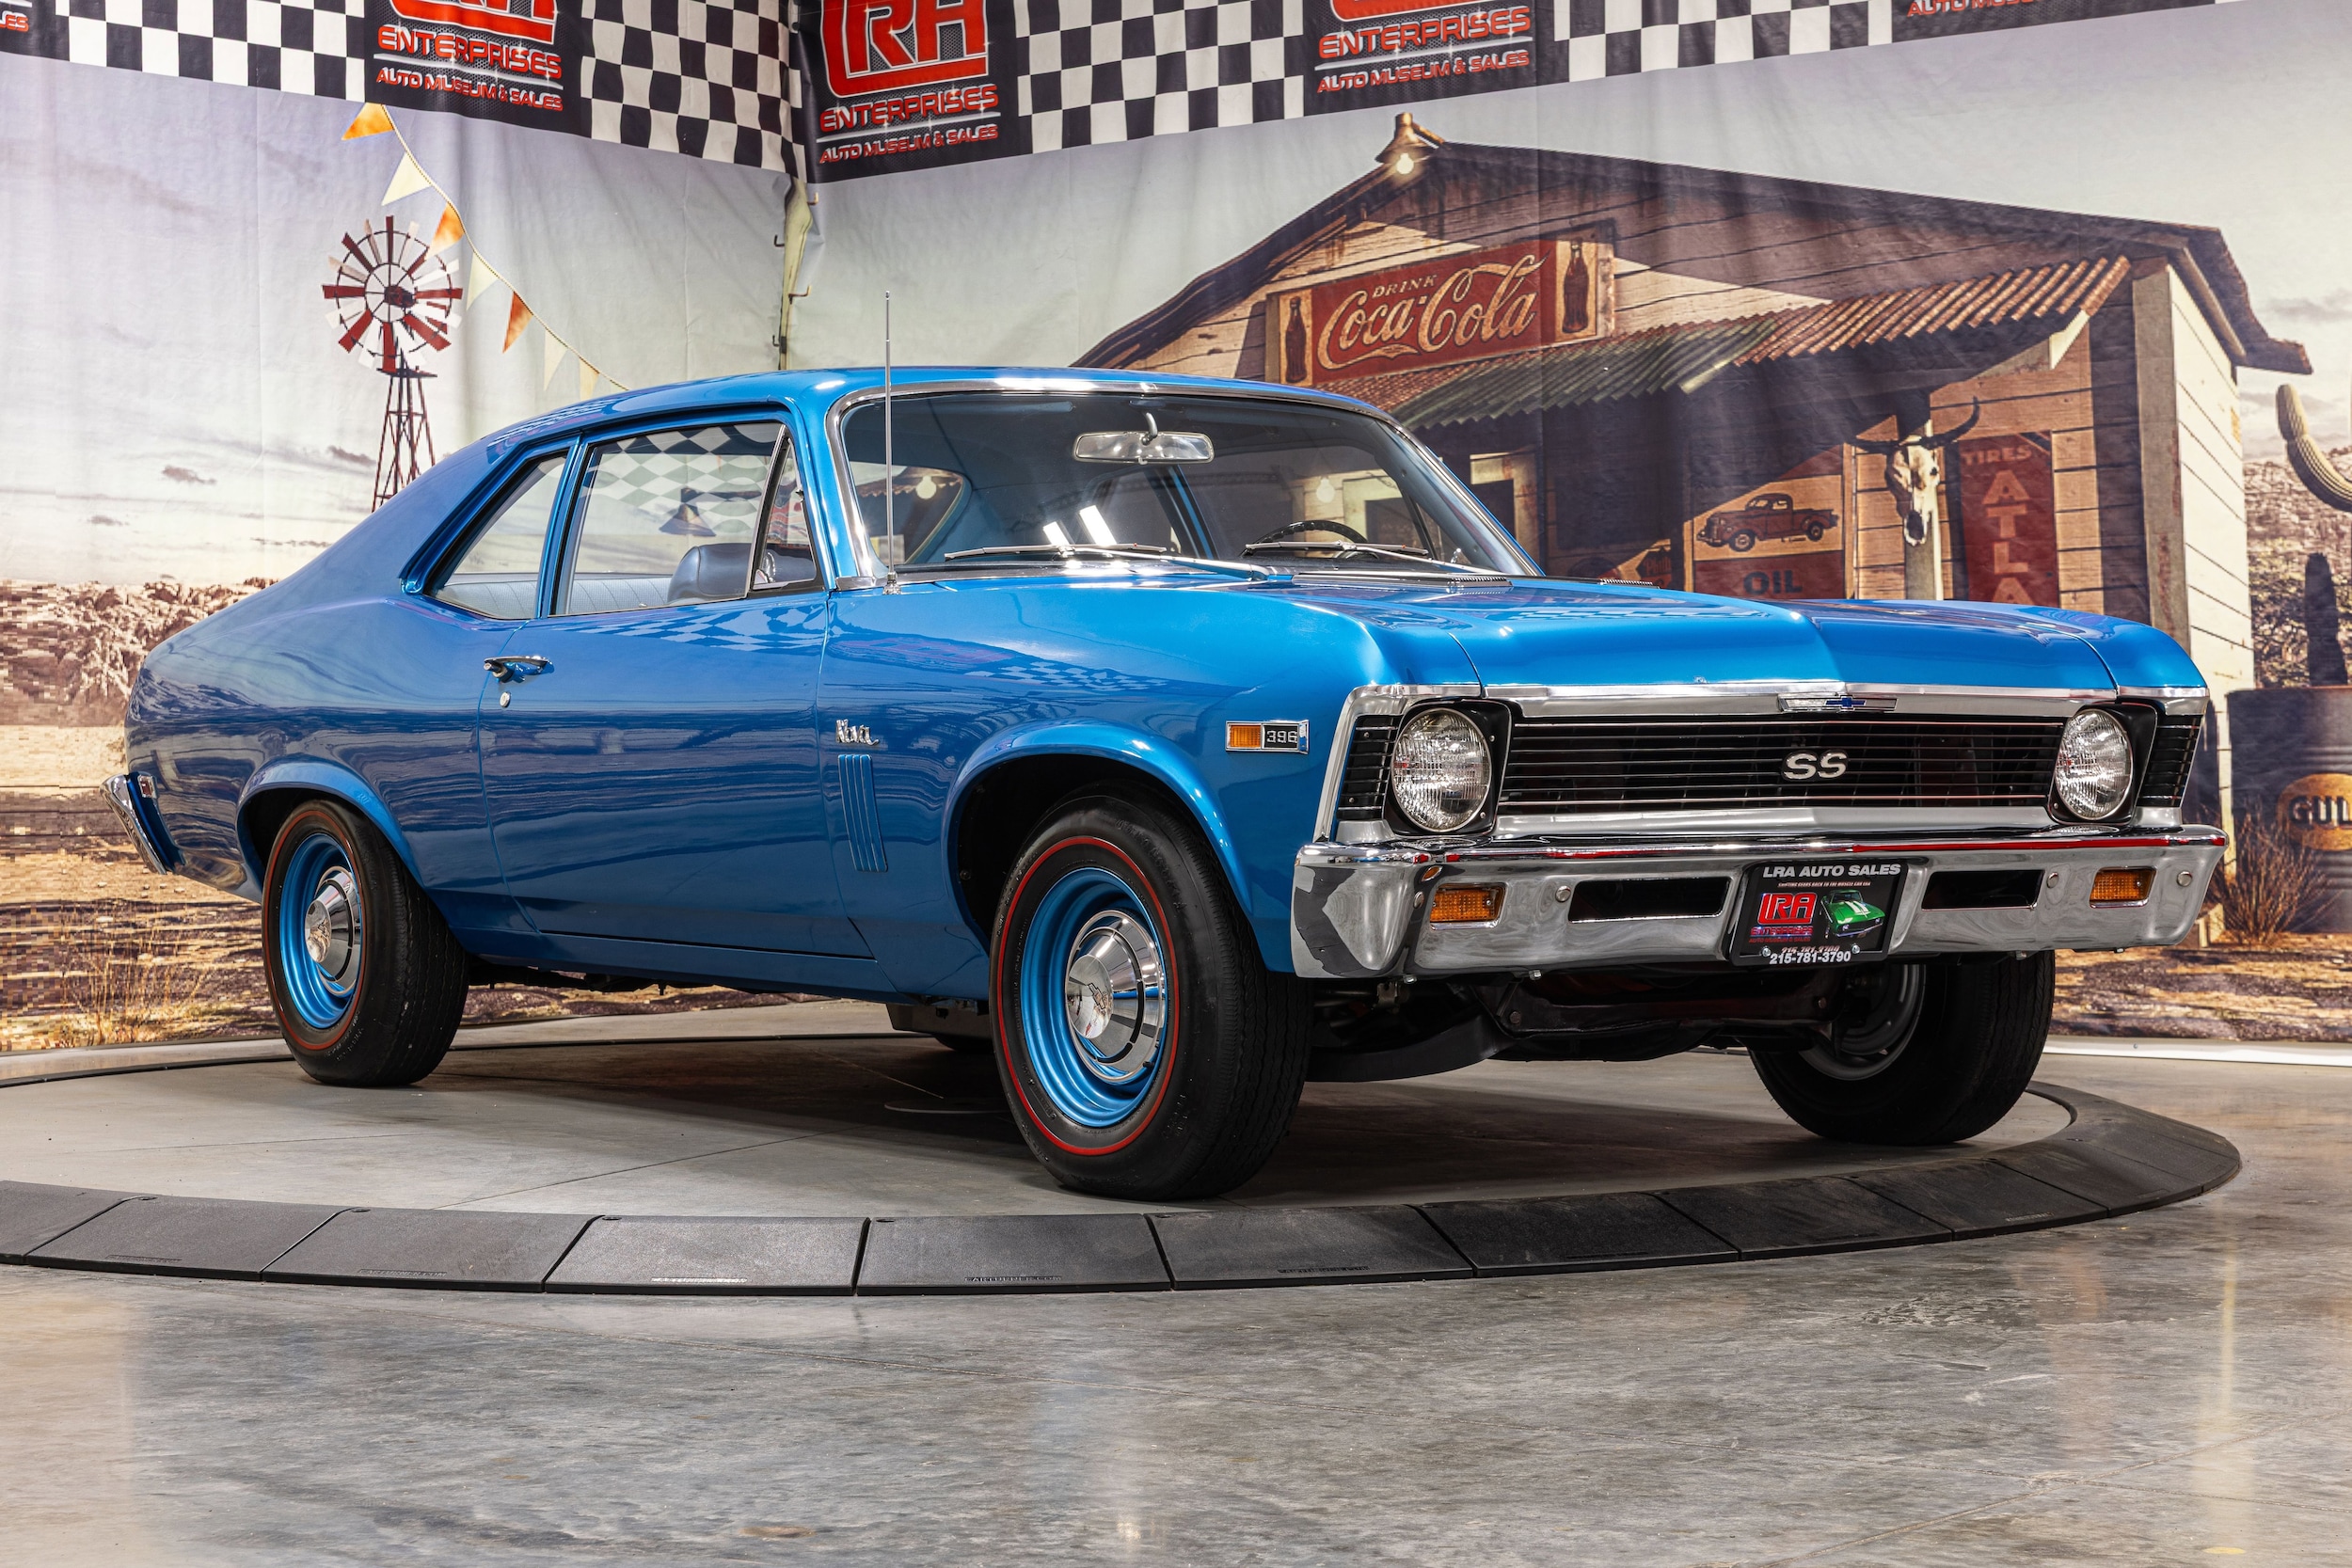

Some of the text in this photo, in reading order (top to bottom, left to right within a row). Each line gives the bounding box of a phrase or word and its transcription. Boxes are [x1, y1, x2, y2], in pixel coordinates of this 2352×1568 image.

[1318, 6, 1532, 59] ENTERPRISES
[377, 24, 563, 79] ENTERPRISES
[1317, 50, 1530, 93] AUTO MUSEUM & SALES
[376, 67, 564, 112] AUTO MUSEUM & SALES
[819, 84, 999, 133] ENTERPRISES
[819, 123, 998, 164] AUTO MUSEUM & SALES
[1372, 274, 1439, 299] DRINK
[1317, 250, 1551, 370] Coca-Cola
[1961, 444, 2033, 467] TIRES
[1981, 469, 2036, 605] ATLA
[1743, 570, 1804, 595] OIL
[1266, 730, 1297, 743] 396
[1783, 752, 1847, 780] SS
[2288, 795, 2352, 829] GUL
[1762, 863, 1901, 879] LRA AUTO SALES
[1757, 893, 1818, 925] LRA
[1770, 951, 1851, 964] 215-781-3790
